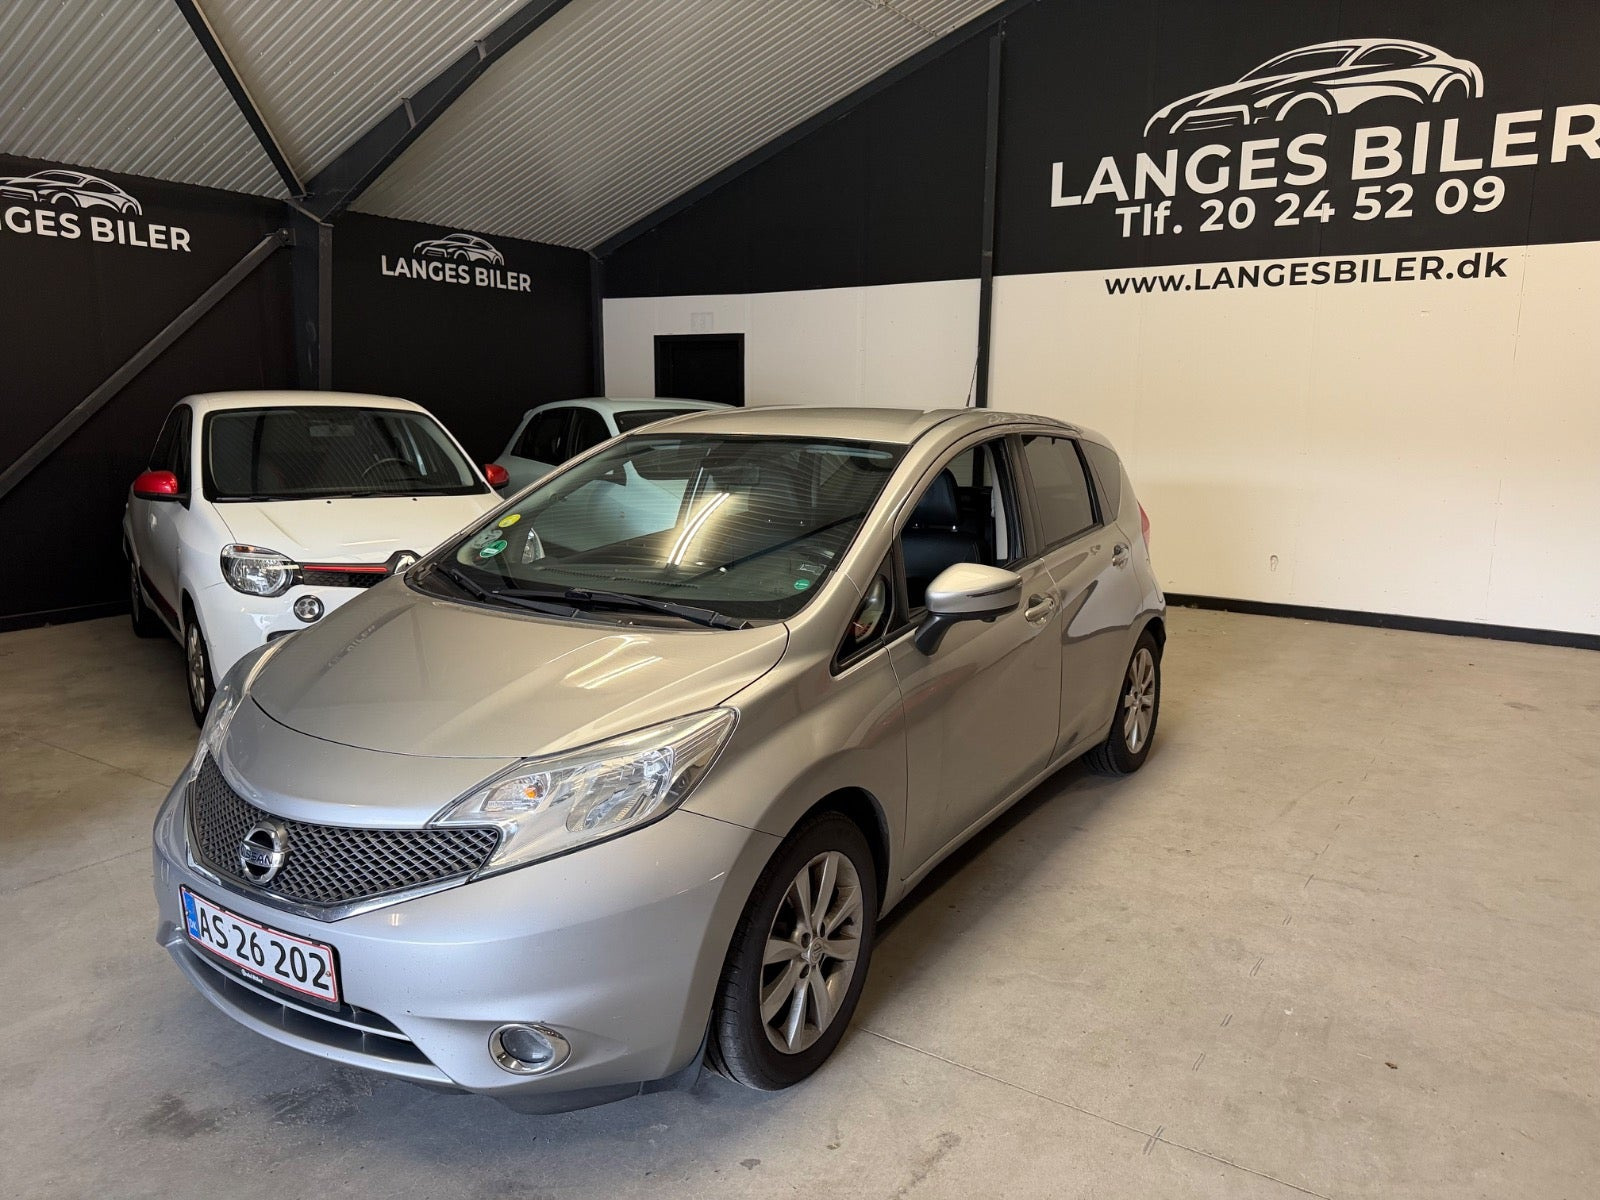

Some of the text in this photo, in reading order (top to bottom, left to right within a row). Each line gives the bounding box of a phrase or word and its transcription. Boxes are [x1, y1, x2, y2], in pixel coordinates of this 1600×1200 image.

[1050, 103, 1600, 208] LANGES BILER
[0, 206, 191, 252] GES BILER
[1115, 175, 1506, 238] Tlf. 20 24 52 09
[381, 254, 531, 292] LANGES BILER
[1104, 251, 1508, 295] www.LANGESBILER.dk
[200, 907, 329, 991] AS 26 202
